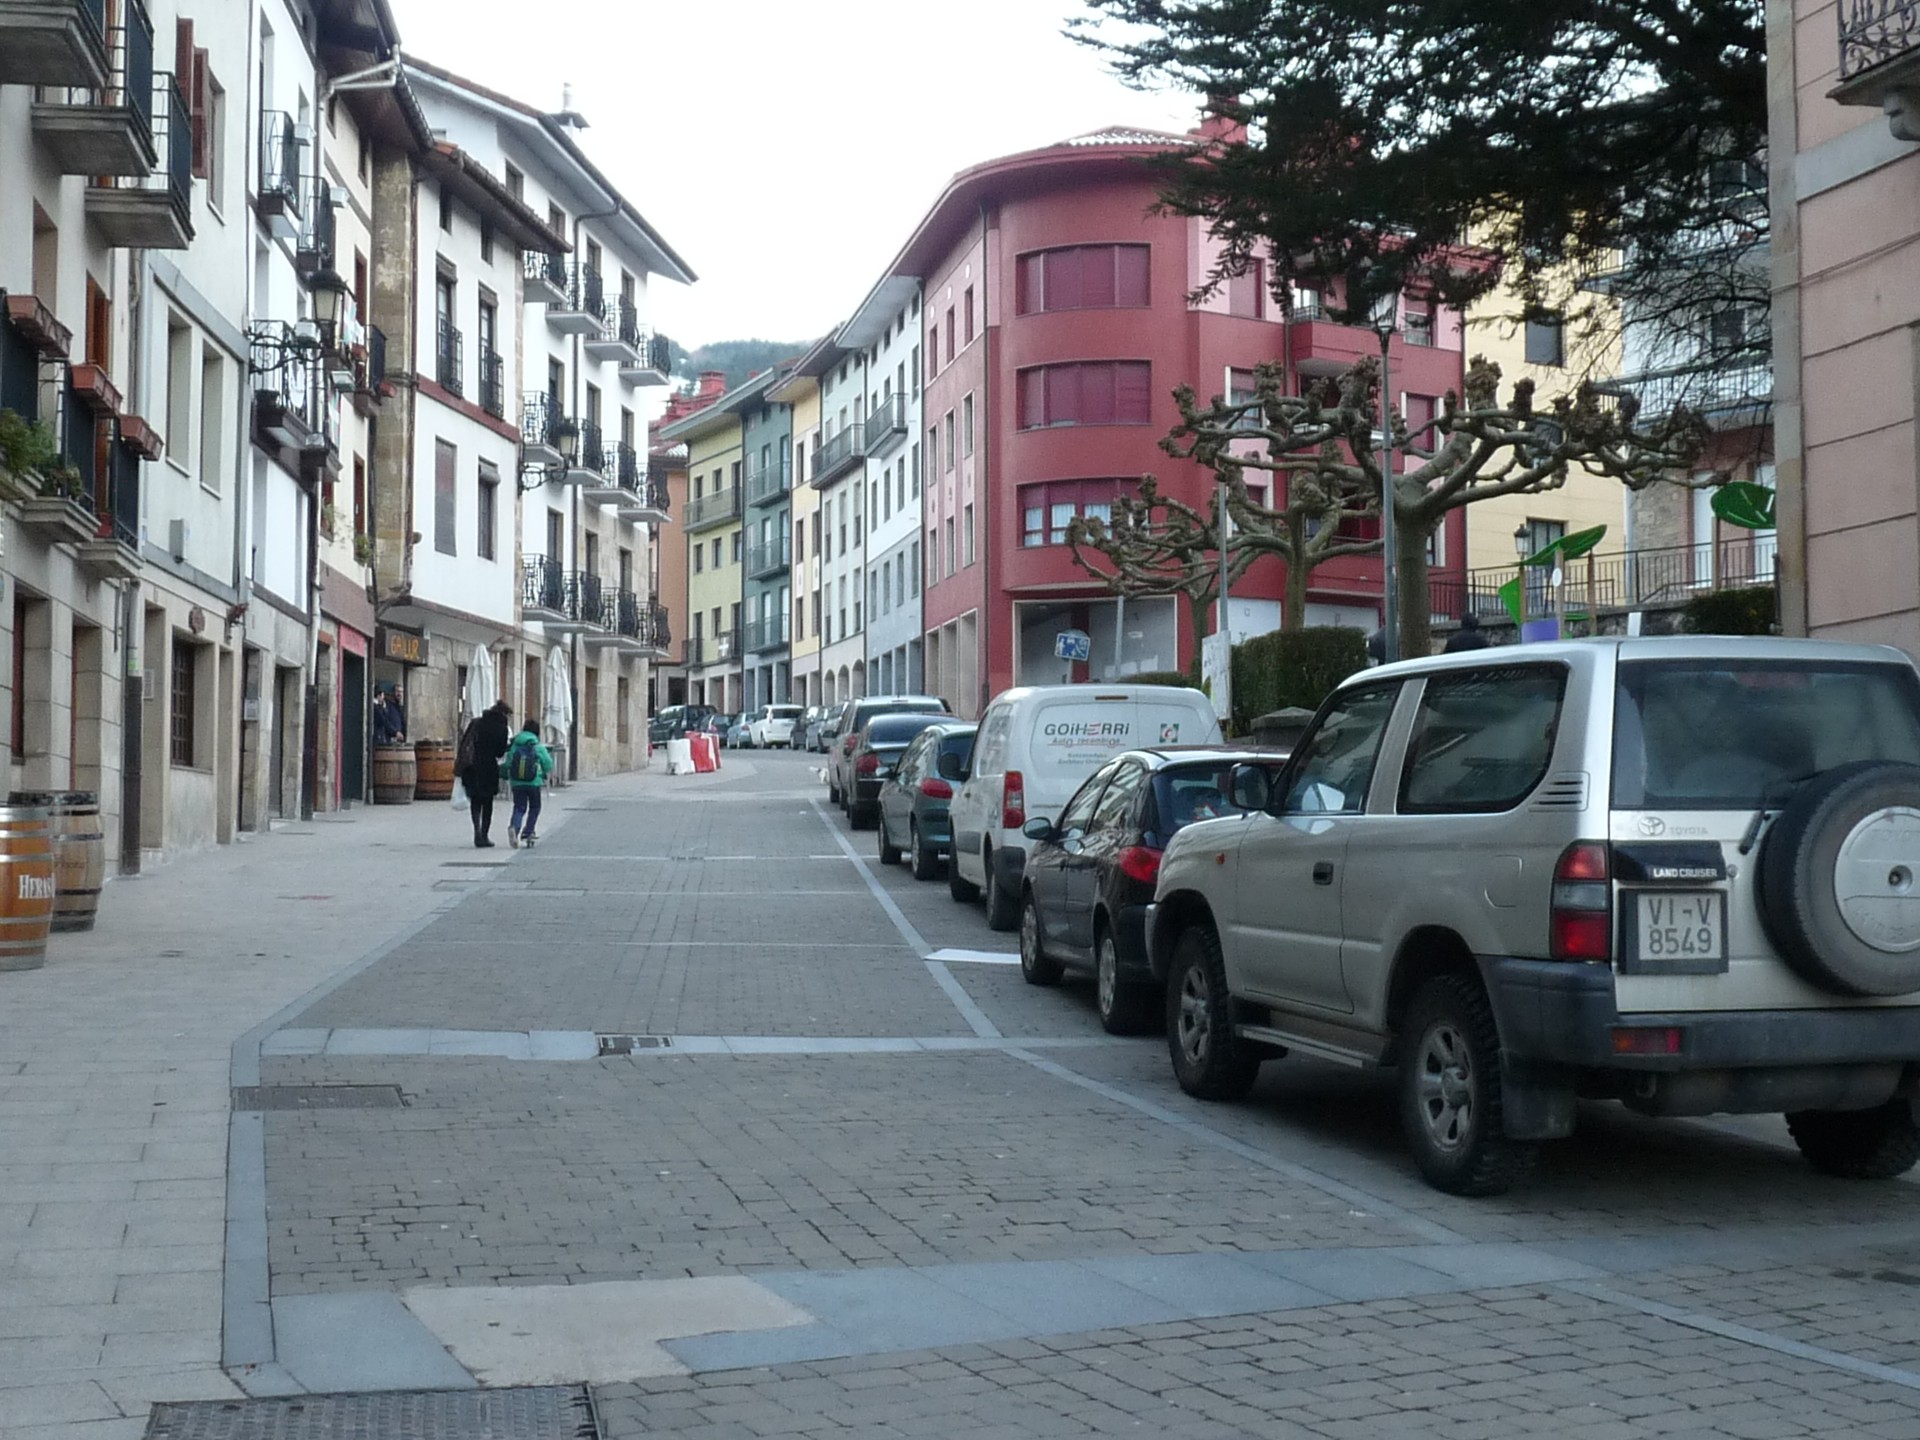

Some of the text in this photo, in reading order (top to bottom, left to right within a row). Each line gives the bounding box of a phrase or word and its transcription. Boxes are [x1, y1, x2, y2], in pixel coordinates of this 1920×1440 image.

[1669, 827, 1709, 835] TOYOTA
[1653, 868, 1718, 878] LAND CRUISER
[1649, 927, 1712, 955] 8549
